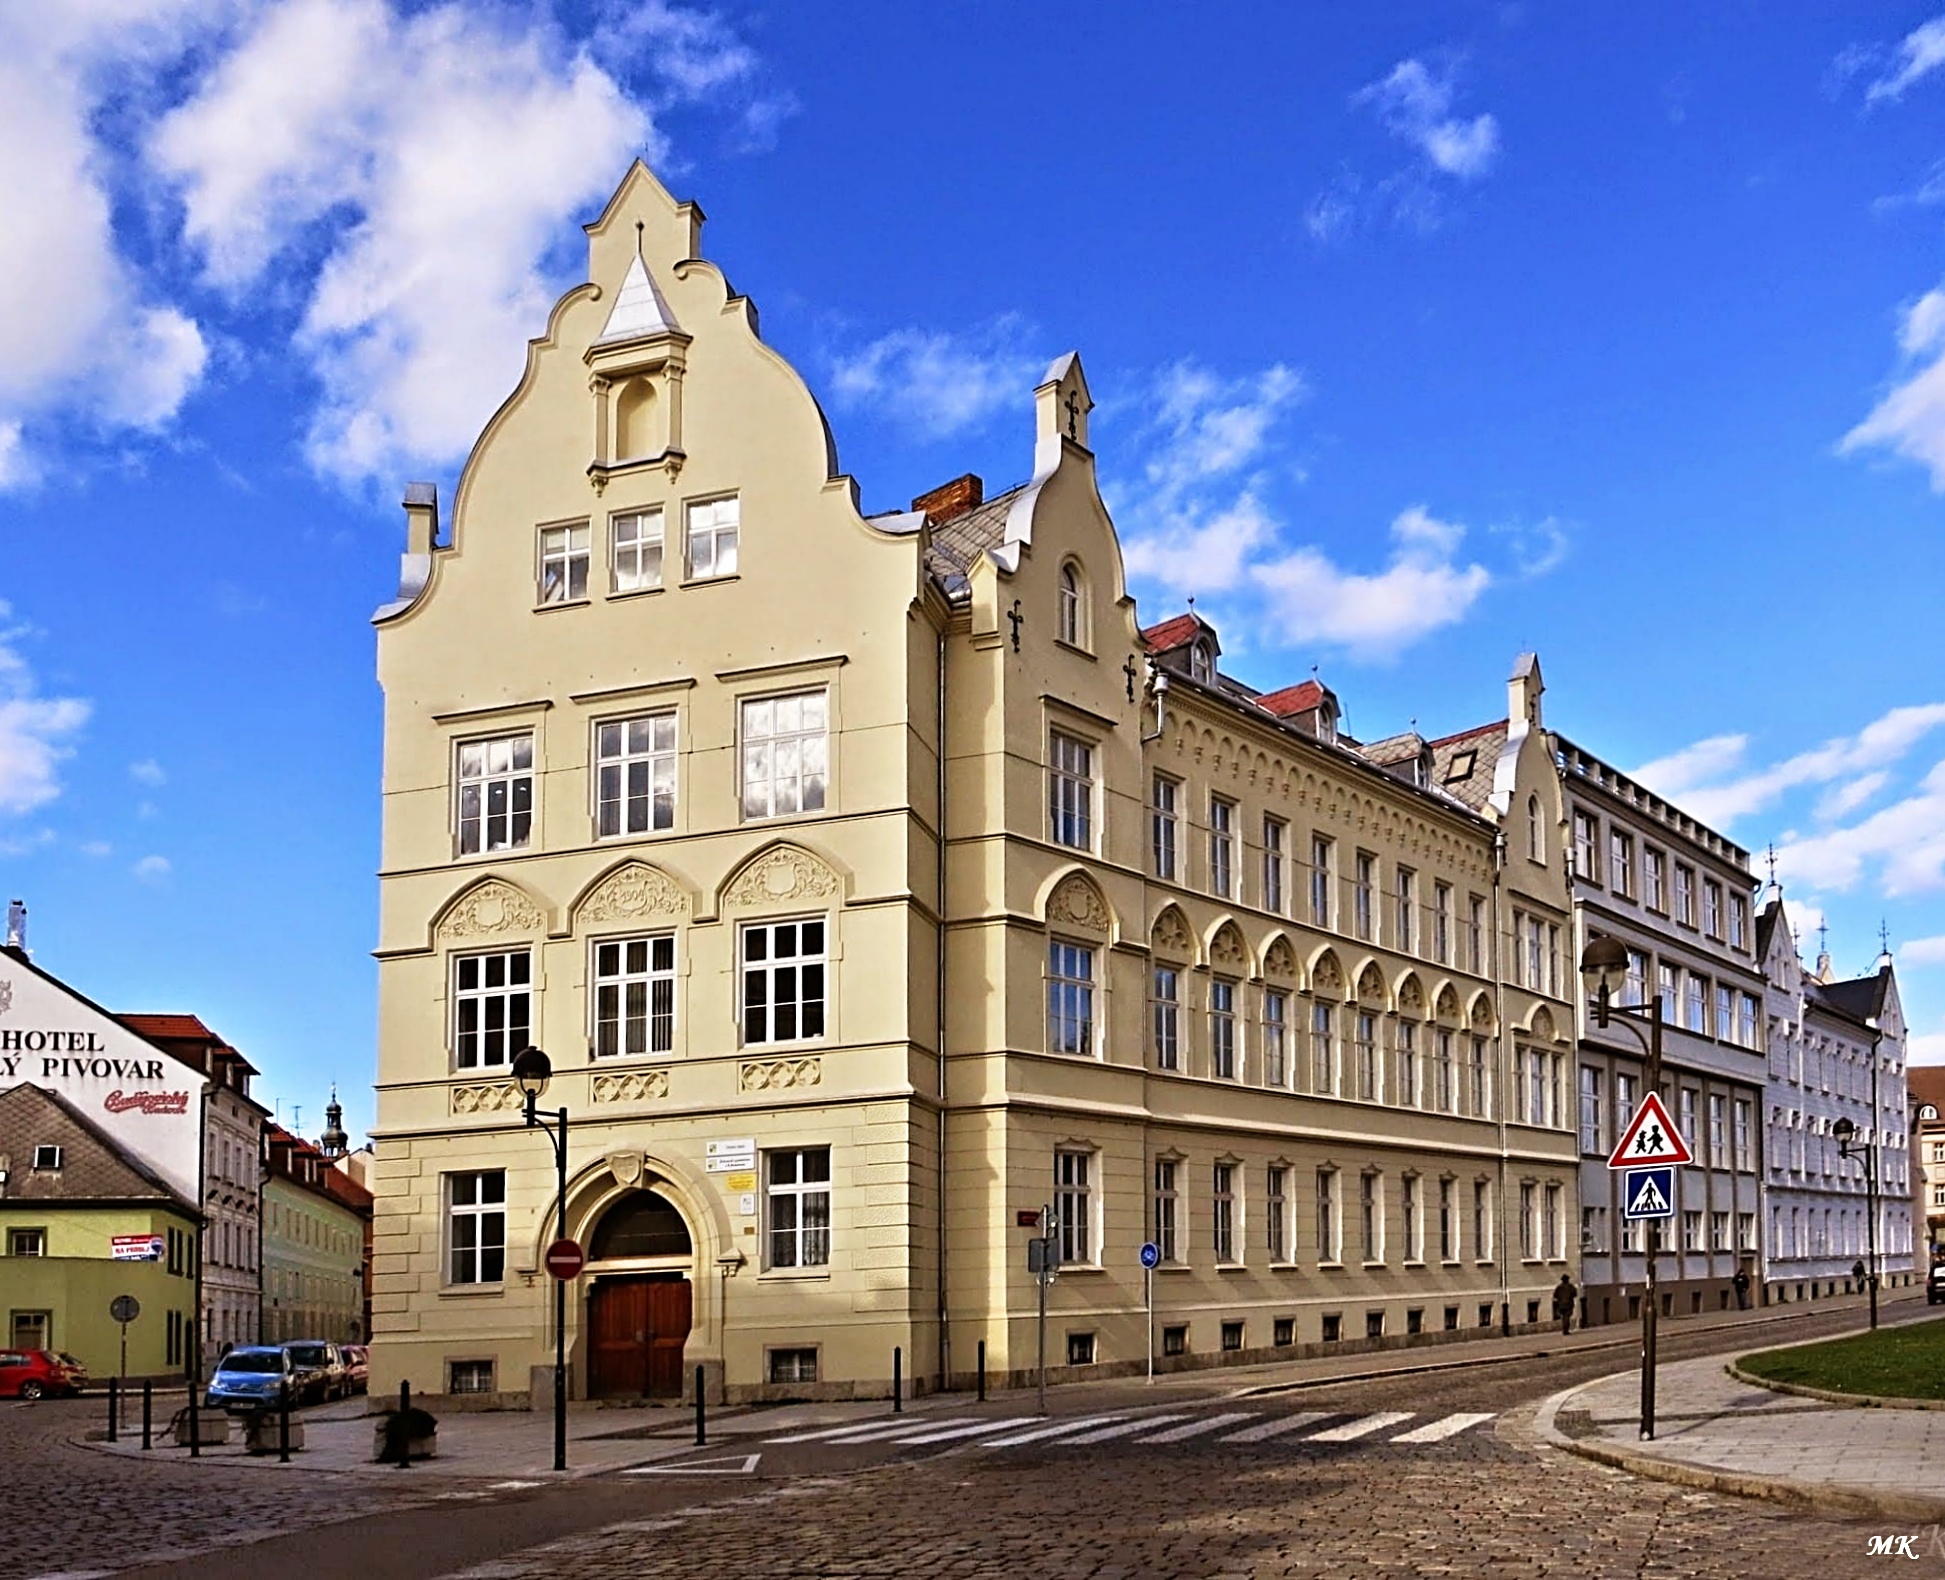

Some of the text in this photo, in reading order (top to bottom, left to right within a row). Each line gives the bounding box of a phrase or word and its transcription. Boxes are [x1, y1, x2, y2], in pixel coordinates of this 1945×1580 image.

[1, 1030, 105, 1052] HOTEL
[0, 1052, 165, 1080] Ý PIVOVAR
